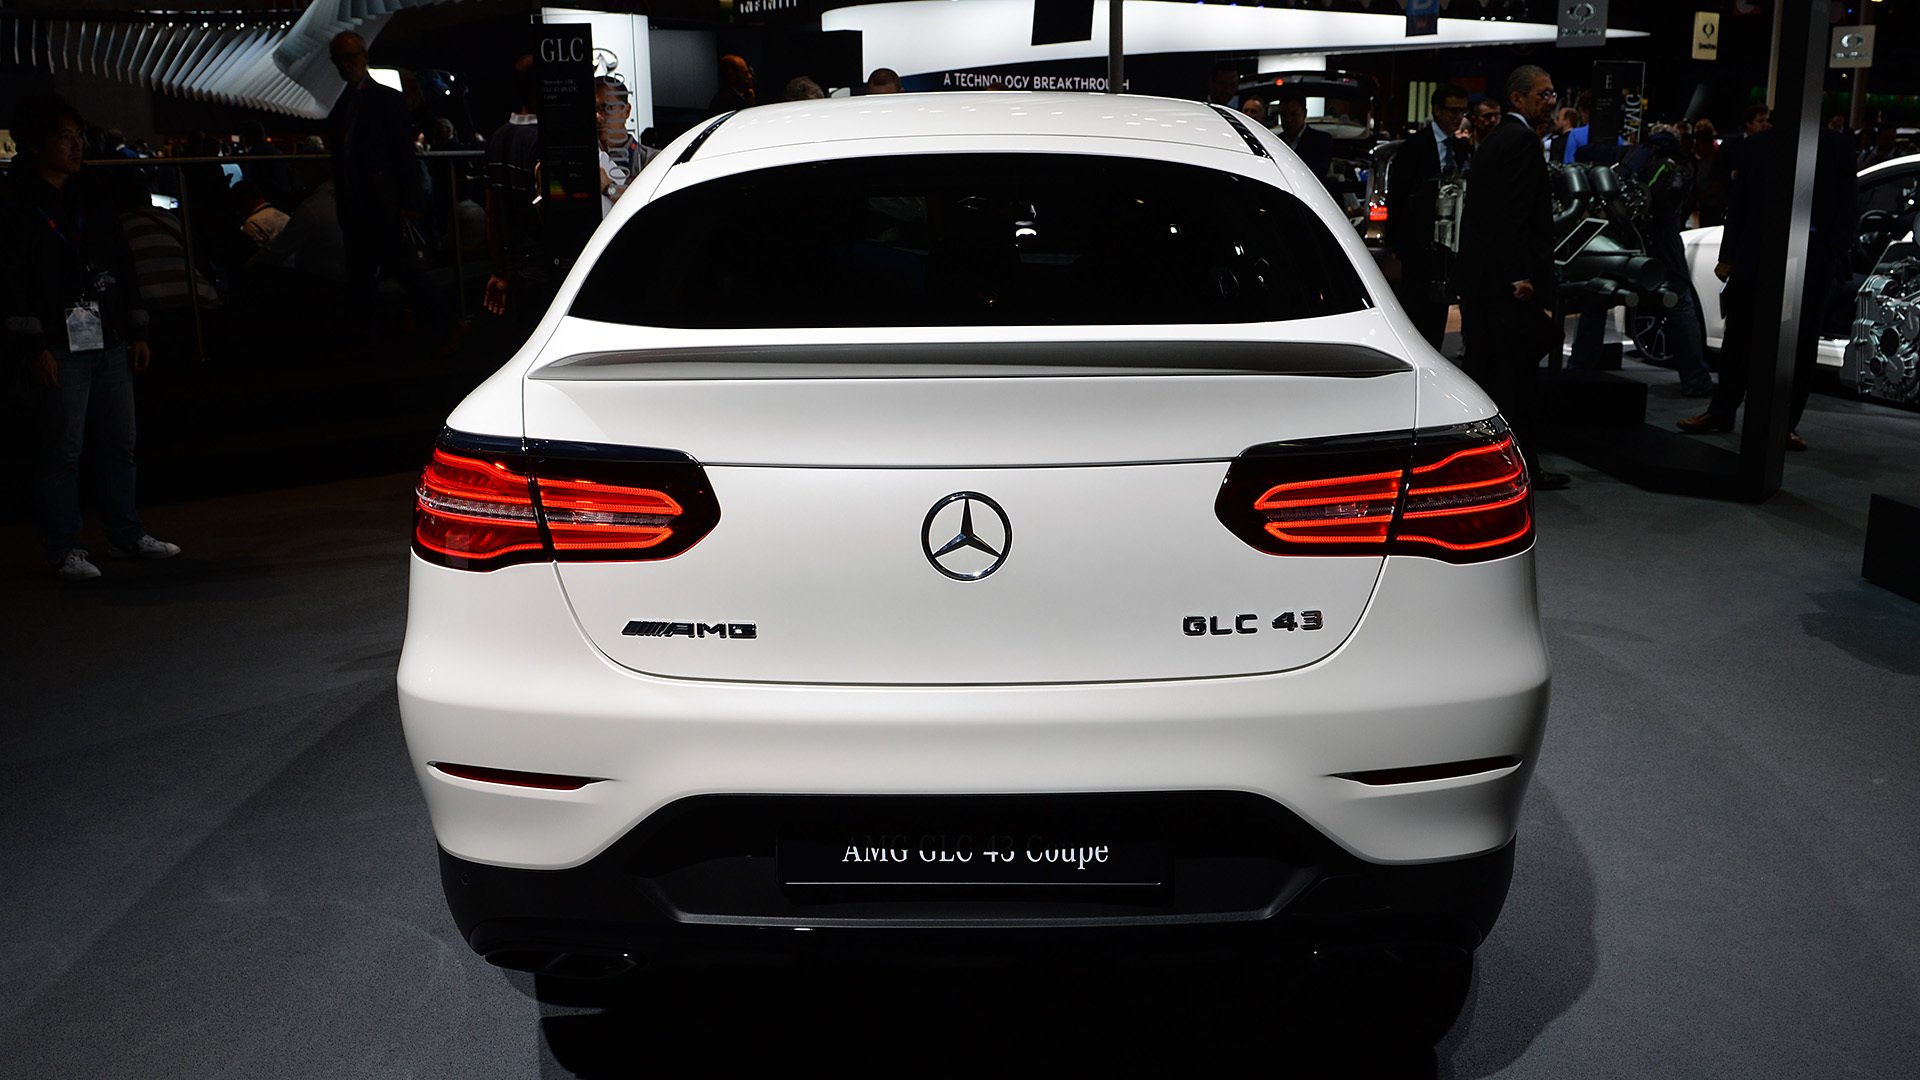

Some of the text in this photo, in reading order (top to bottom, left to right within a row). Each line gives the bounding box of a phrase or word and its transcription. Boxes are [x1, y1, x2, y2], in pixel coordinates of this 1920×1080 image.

[540, 37, 585, 63] GLC
[943, 73, 951, 87] A
[1033, 76, 1130, 91] BREAKTHROH
[660, 621, 757, 638] AMG
[1182, 610, 1324, 636] GLC 43
[841, 835, 908, 863] AMG
[918, 834, 973, 863] GLC
[982, 834, 1016, 863] 43
